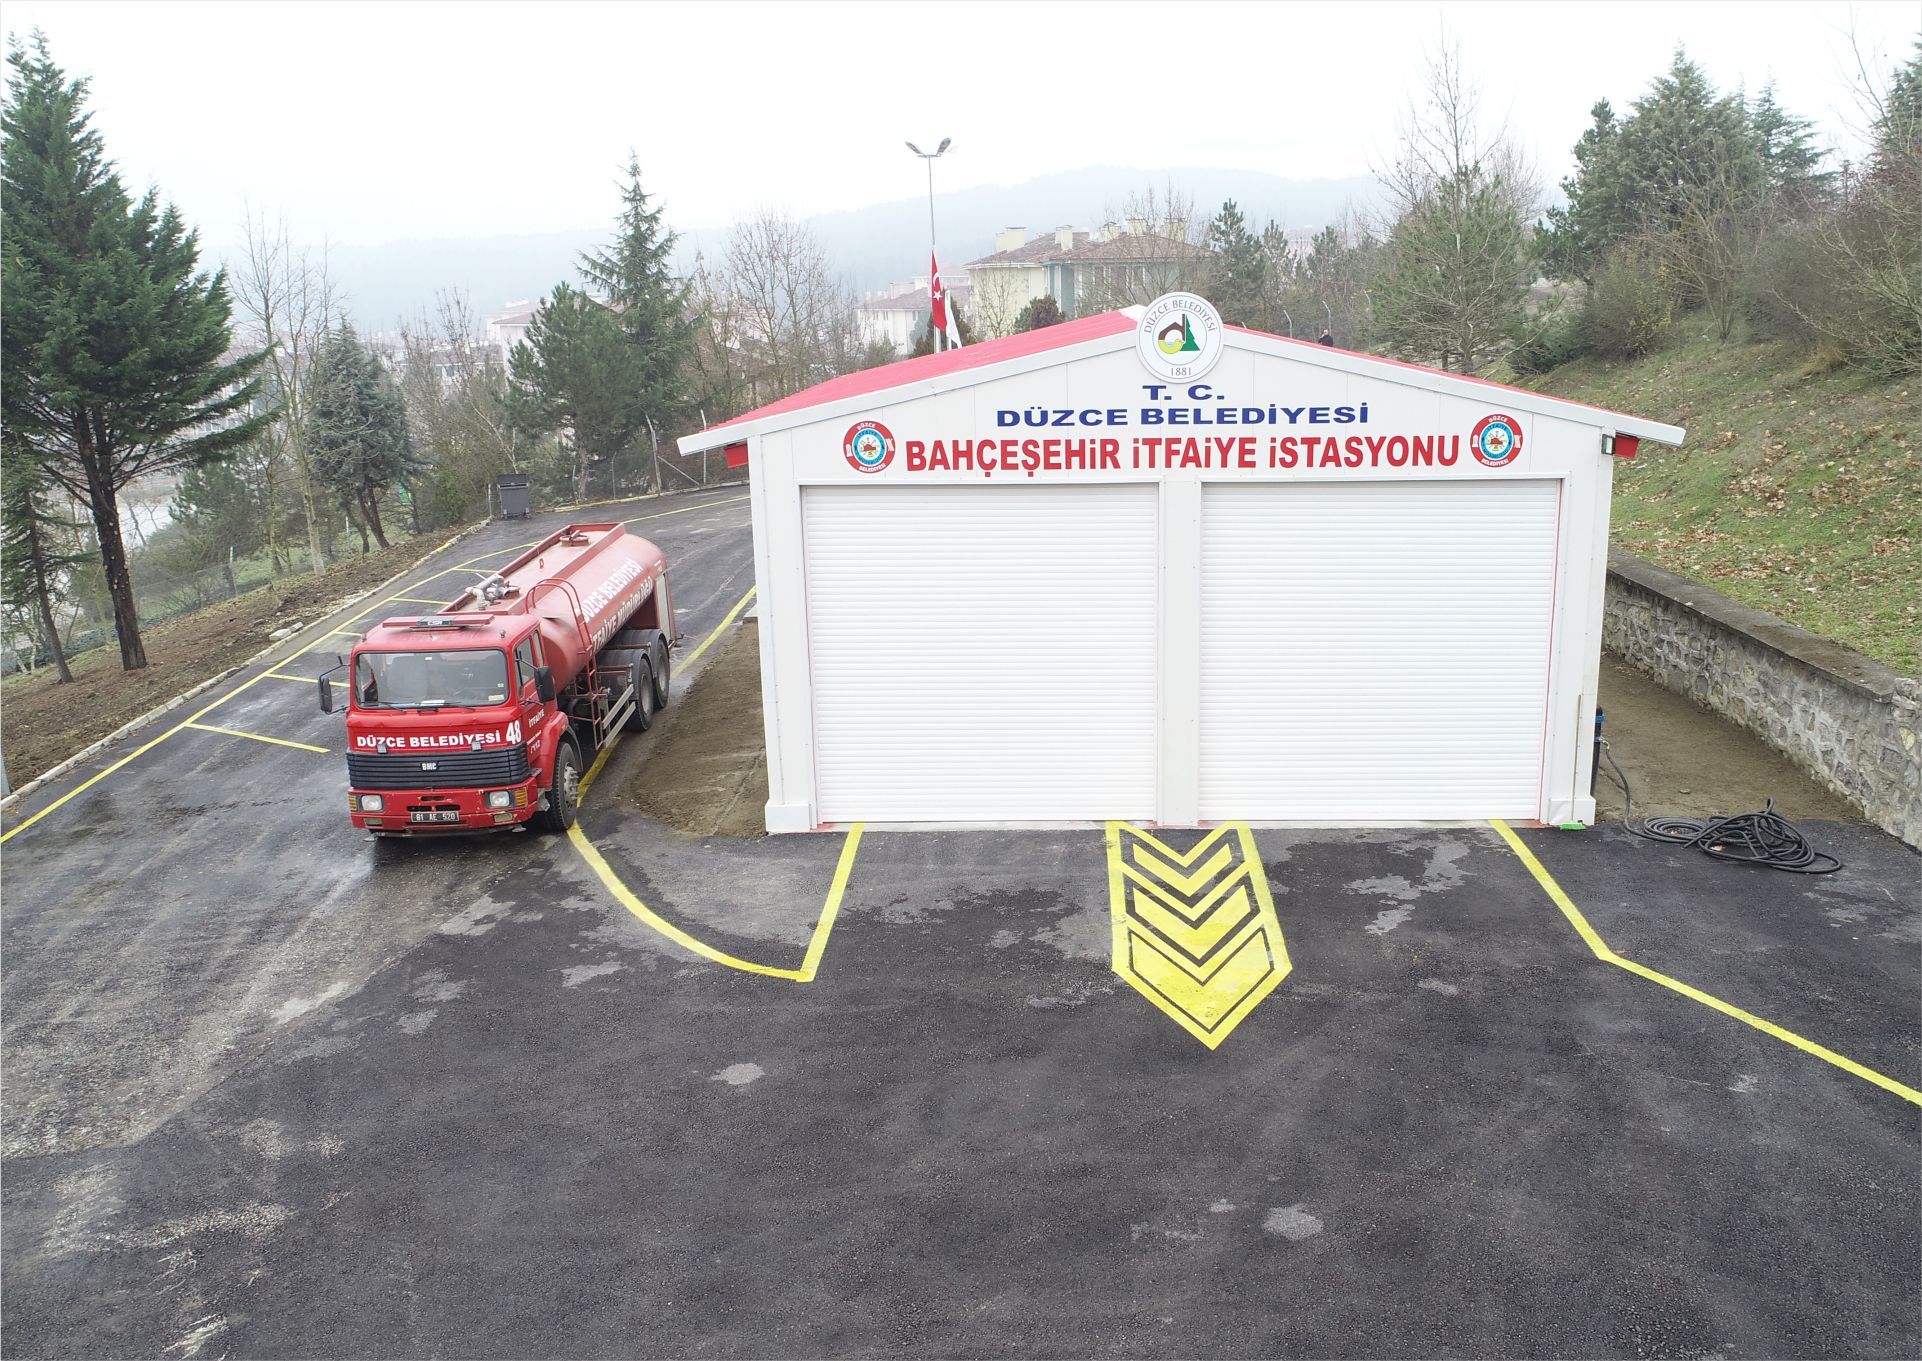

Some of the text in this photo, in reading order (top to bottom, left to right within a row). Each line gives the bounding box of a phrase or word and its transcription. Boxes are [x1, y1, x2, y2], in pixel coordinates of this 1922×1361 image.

[1144, 299, 1218, 333] DÜZCE BELEDİYESİ
[1171, 367, 1192, 376] 1881
[1142, 384, 1225, 401] T. C.
[996, 402, 1369, 427] DÜZCE BELEDİYESİ
[357, 730, 501, 747] DÜZCE BELEDİYESİ
[506, 720, 522, 745] 48
[422, 762, 437, 770] BMC
